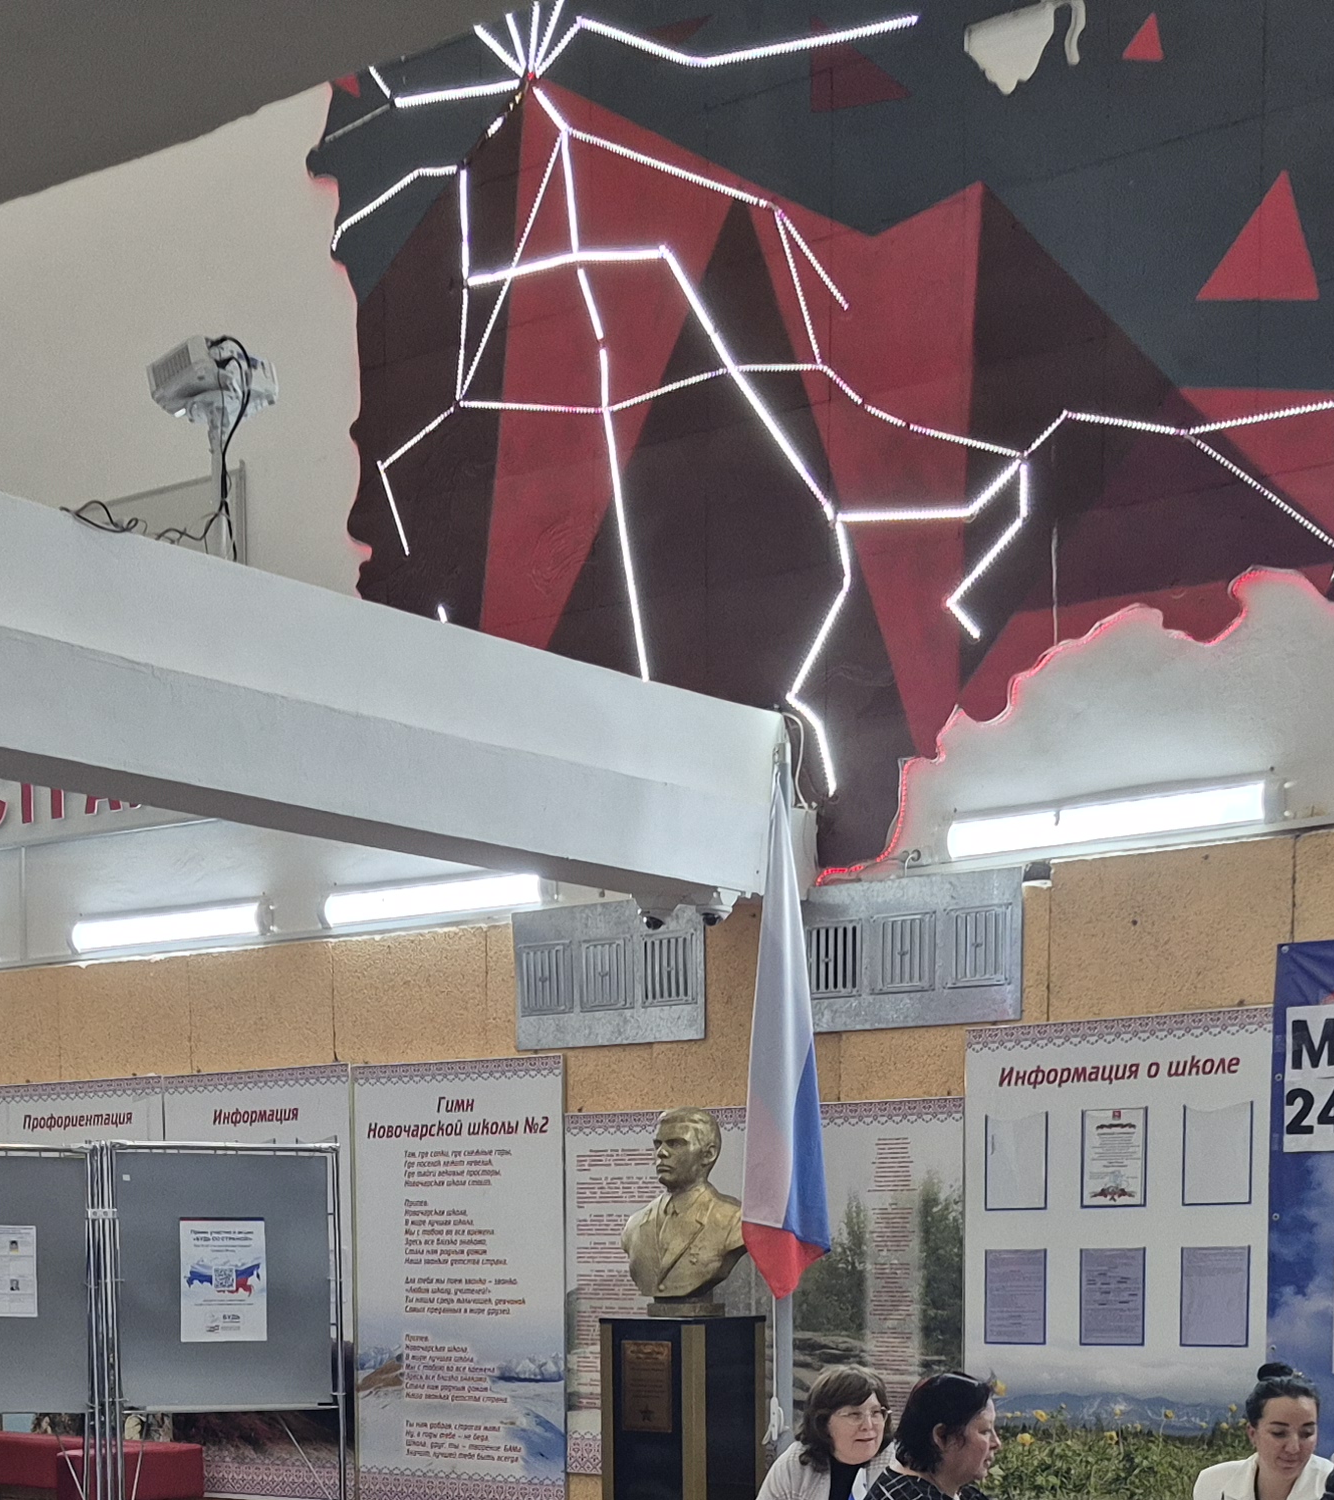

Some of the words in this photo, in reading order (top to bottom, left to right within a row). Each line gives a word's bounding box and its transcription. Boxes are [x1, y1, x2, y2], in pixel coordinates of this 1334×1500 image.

[998, 1059, 1140, 1088] Информация
[1147, 1062, 1161, 1080] о
[1167, 1055, 1241, 1078] школе
[436, 1096, 475, 1113] Гимн
[23, 1110, 133, 1131] Профориентация
[213, 1107, 299, 1127] Информация
[367, 1119, 463, 1141] Новочарской
[467, 1118, 520, 1136] школы
[523, 1116, 550, 1134] №2
